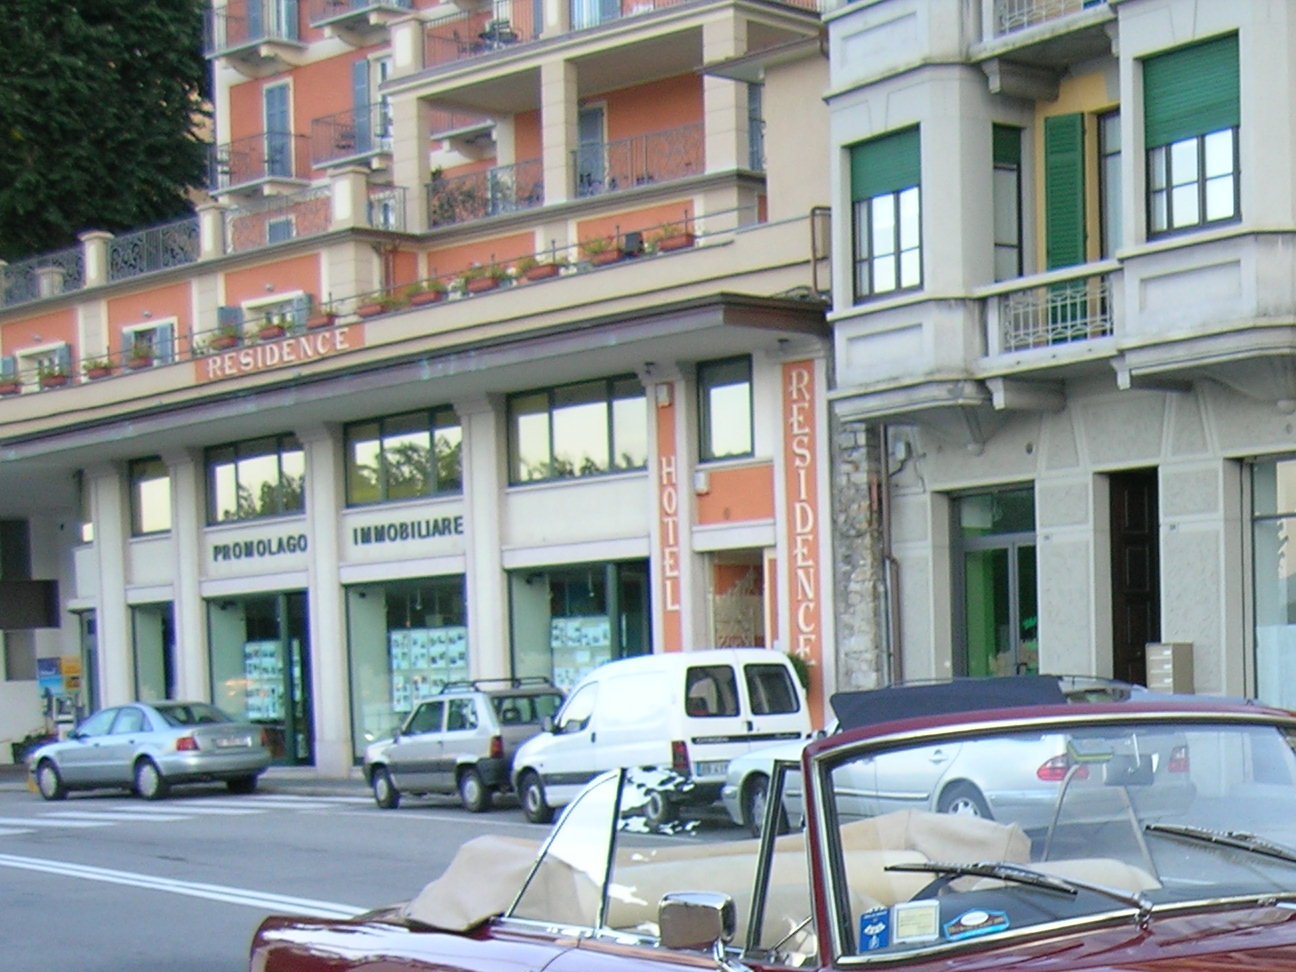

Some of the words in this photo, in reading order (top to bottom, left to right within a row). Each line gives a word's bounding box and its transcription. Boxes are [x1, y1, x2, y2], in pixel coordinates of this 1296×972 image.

[207, 327, 350, 378] RESIDENCE
[353, 515, 464, 546] IMMOBILIARE
[661, 456, 681, 612] HOTEL
[789, 368, 818, 666] RESIDENCE
[213, 533, 308, 562] PROMOLAGO
